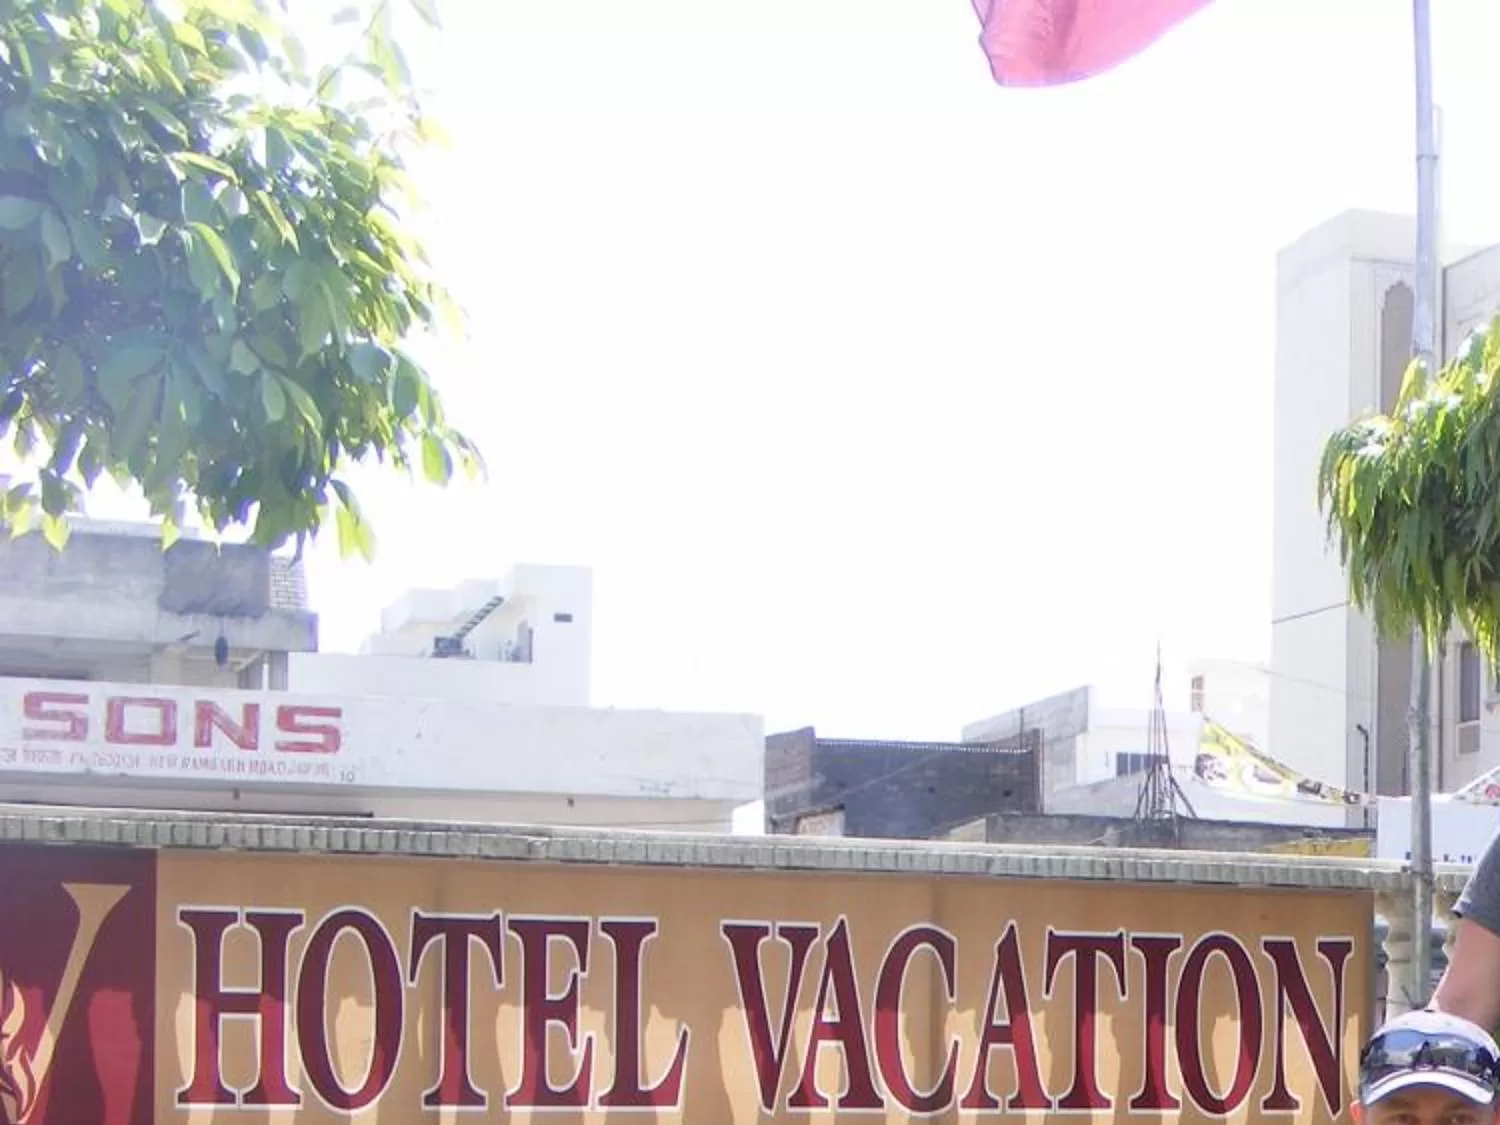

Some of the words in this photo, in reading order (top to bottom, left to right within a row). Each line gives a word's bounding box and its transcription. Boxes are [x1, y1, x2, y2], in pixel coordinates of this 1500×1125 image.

[22, 691, 343, 754] SONS
[176, 905, 691, 1115] HOTEL
[720, 914, 1354, 1121] VACATION
